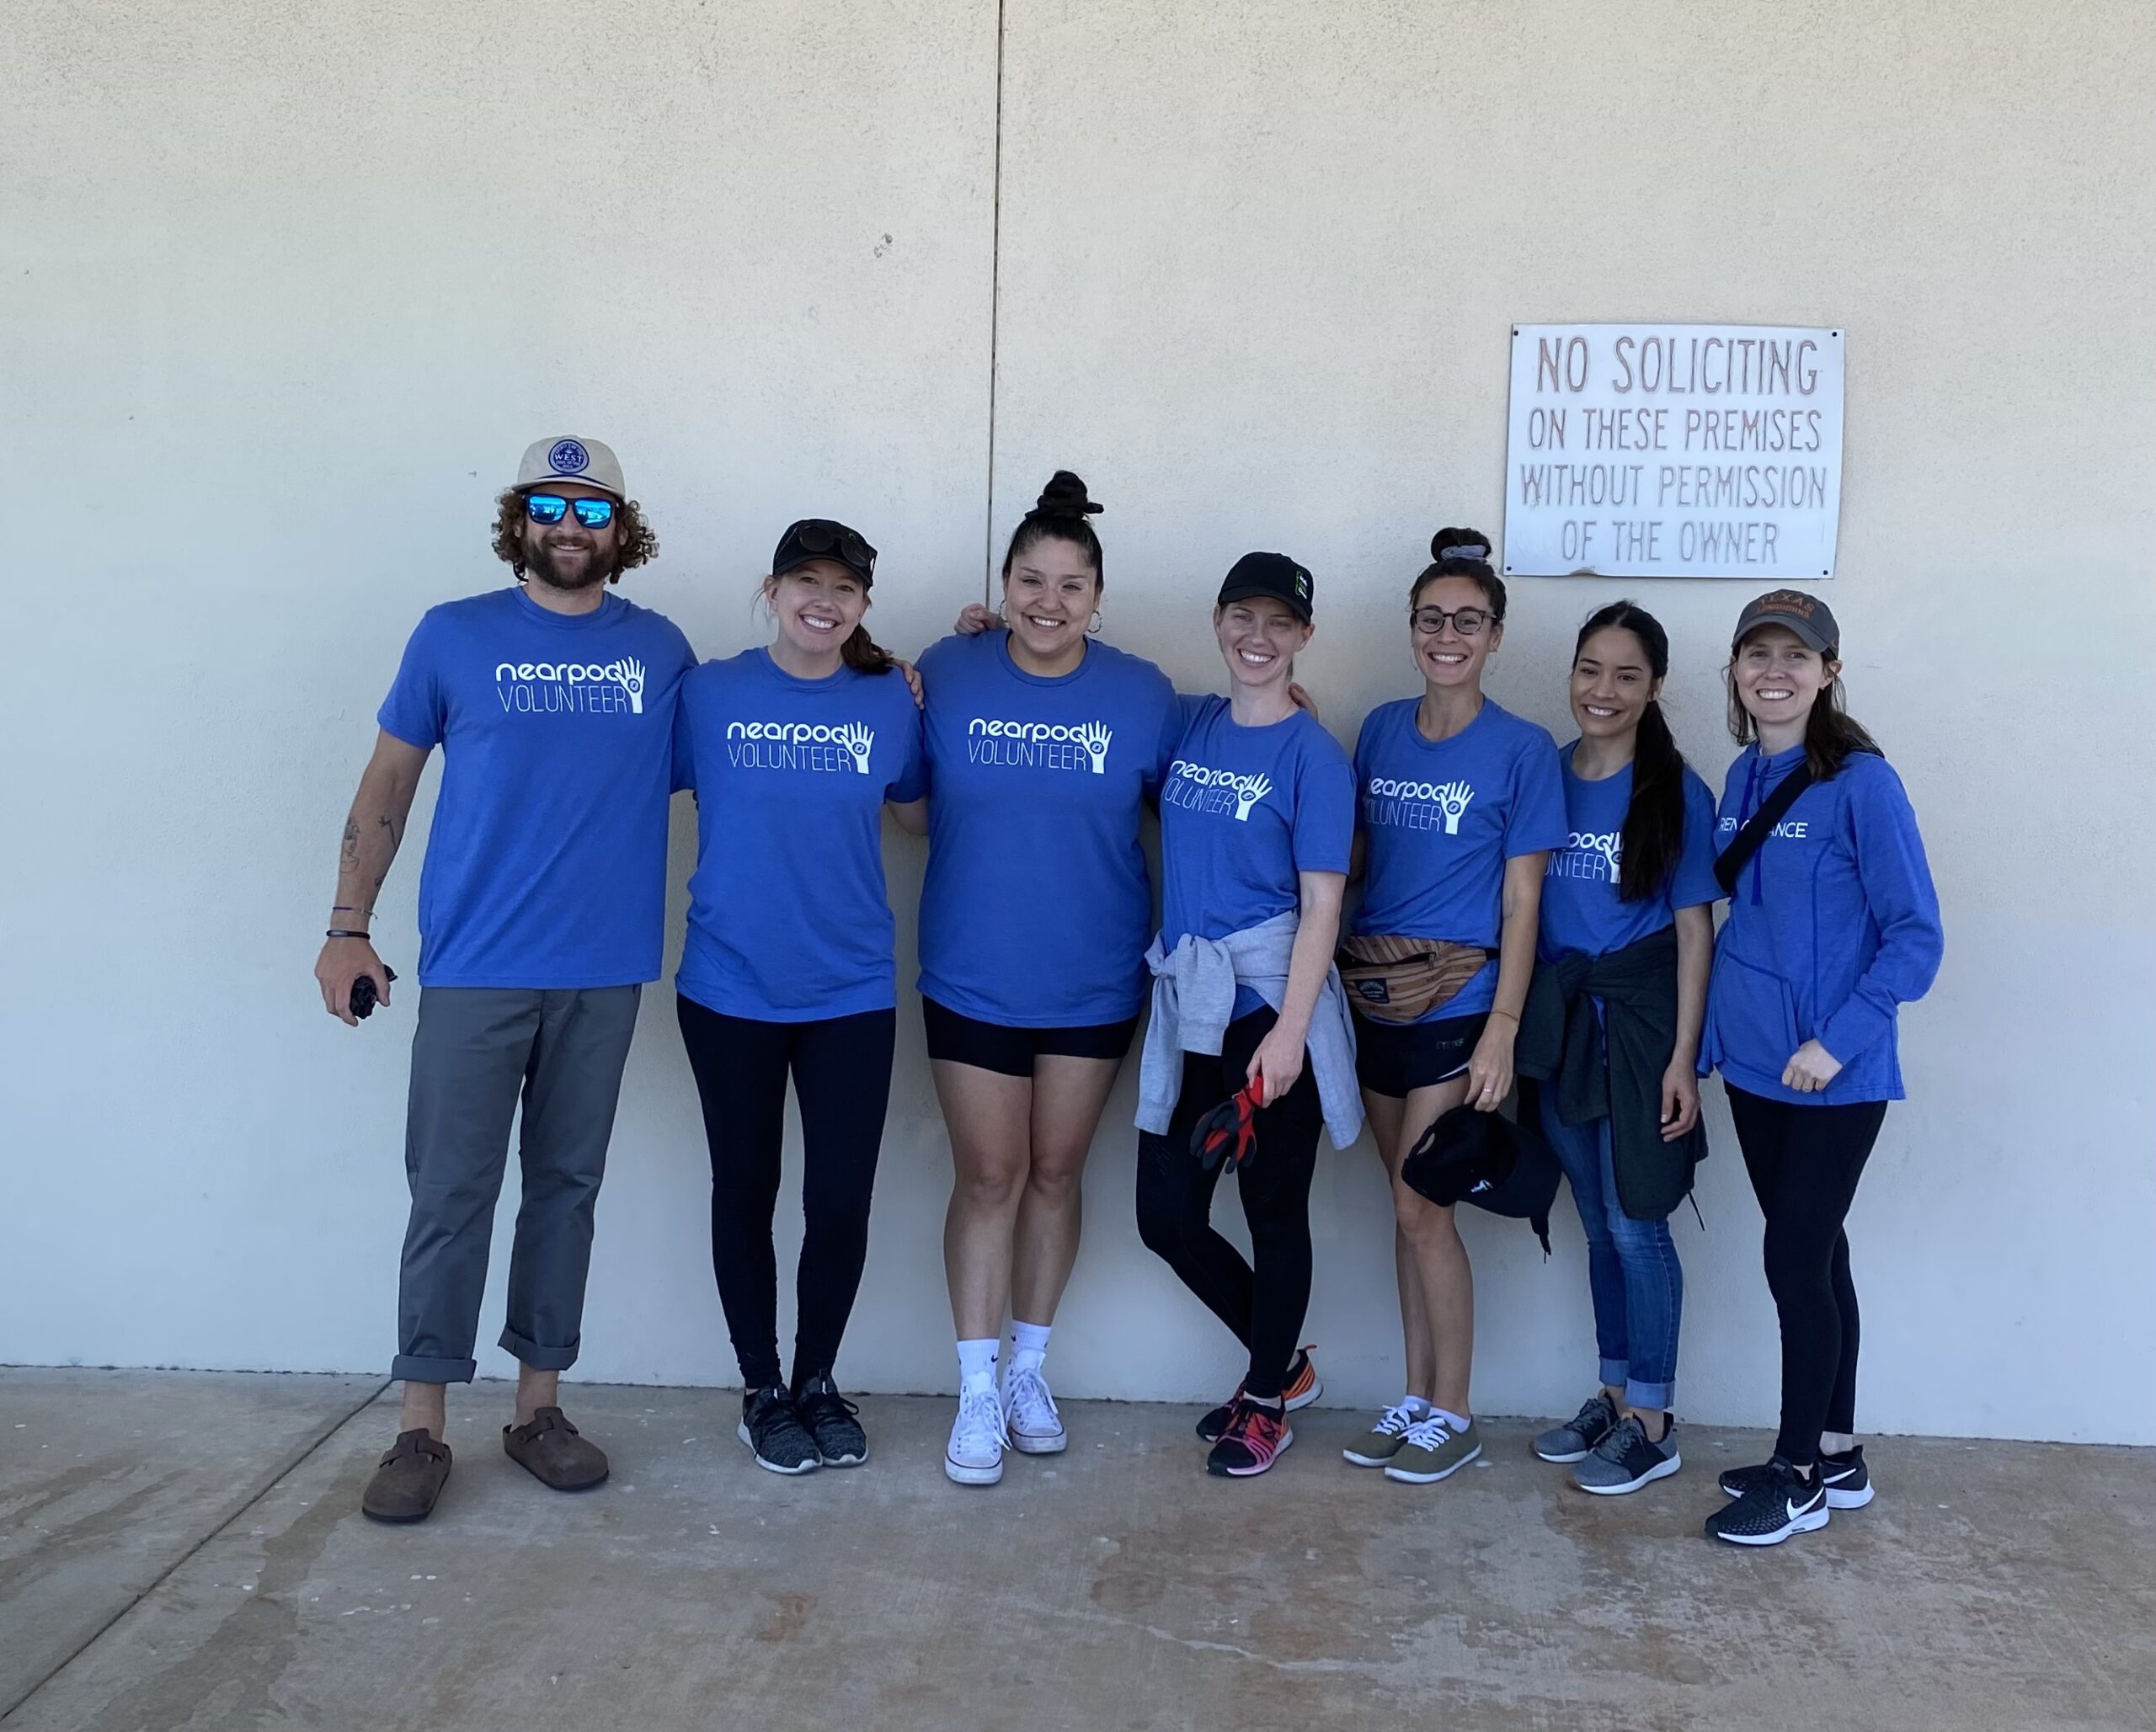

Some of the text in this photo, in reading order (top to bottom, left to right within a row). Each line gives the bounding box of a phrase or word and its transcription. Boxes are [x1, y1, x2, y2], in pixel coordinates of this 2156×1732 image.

[1536, 336, 1817, 395] NO SOLICITING
[1529, 407, 1822, 451] ON THESE PREMISES
[555, 453, 583, 462] WEST
[1520, 464, 1828, 508] WITHOUT PERMISSION
[1562, 520, 1779, 563] OF THE OWNER
[1759, 591, 1815, 612] TEXAS
[497, 685, 627, 713] VOLUNTEER
[728, 743, 852, 772] VOLUNTEER
[968, 739, 1086, 771] VOLUNTEER
[1369, 777, 1451, 801] earpod
